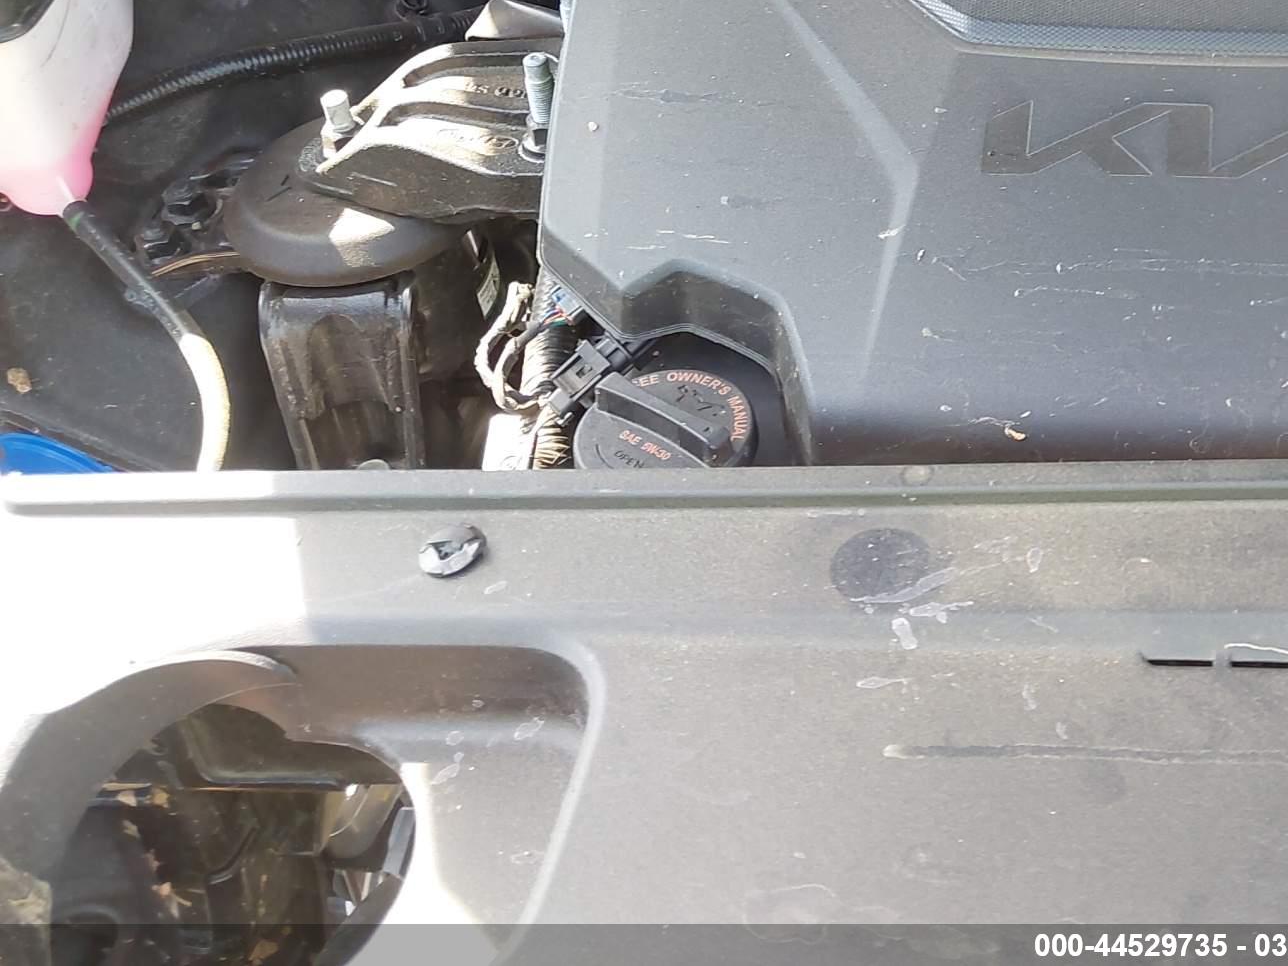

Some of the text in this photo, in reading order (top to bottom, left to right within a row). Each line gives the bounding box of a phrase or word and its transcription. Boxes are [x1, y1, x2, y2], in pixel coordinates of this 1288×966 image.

[666, 372, 732, 395] OWNER'S
[727, 395, 748, 441] MANUAL
[619, 430, 671, 461] SAE 5W-30
